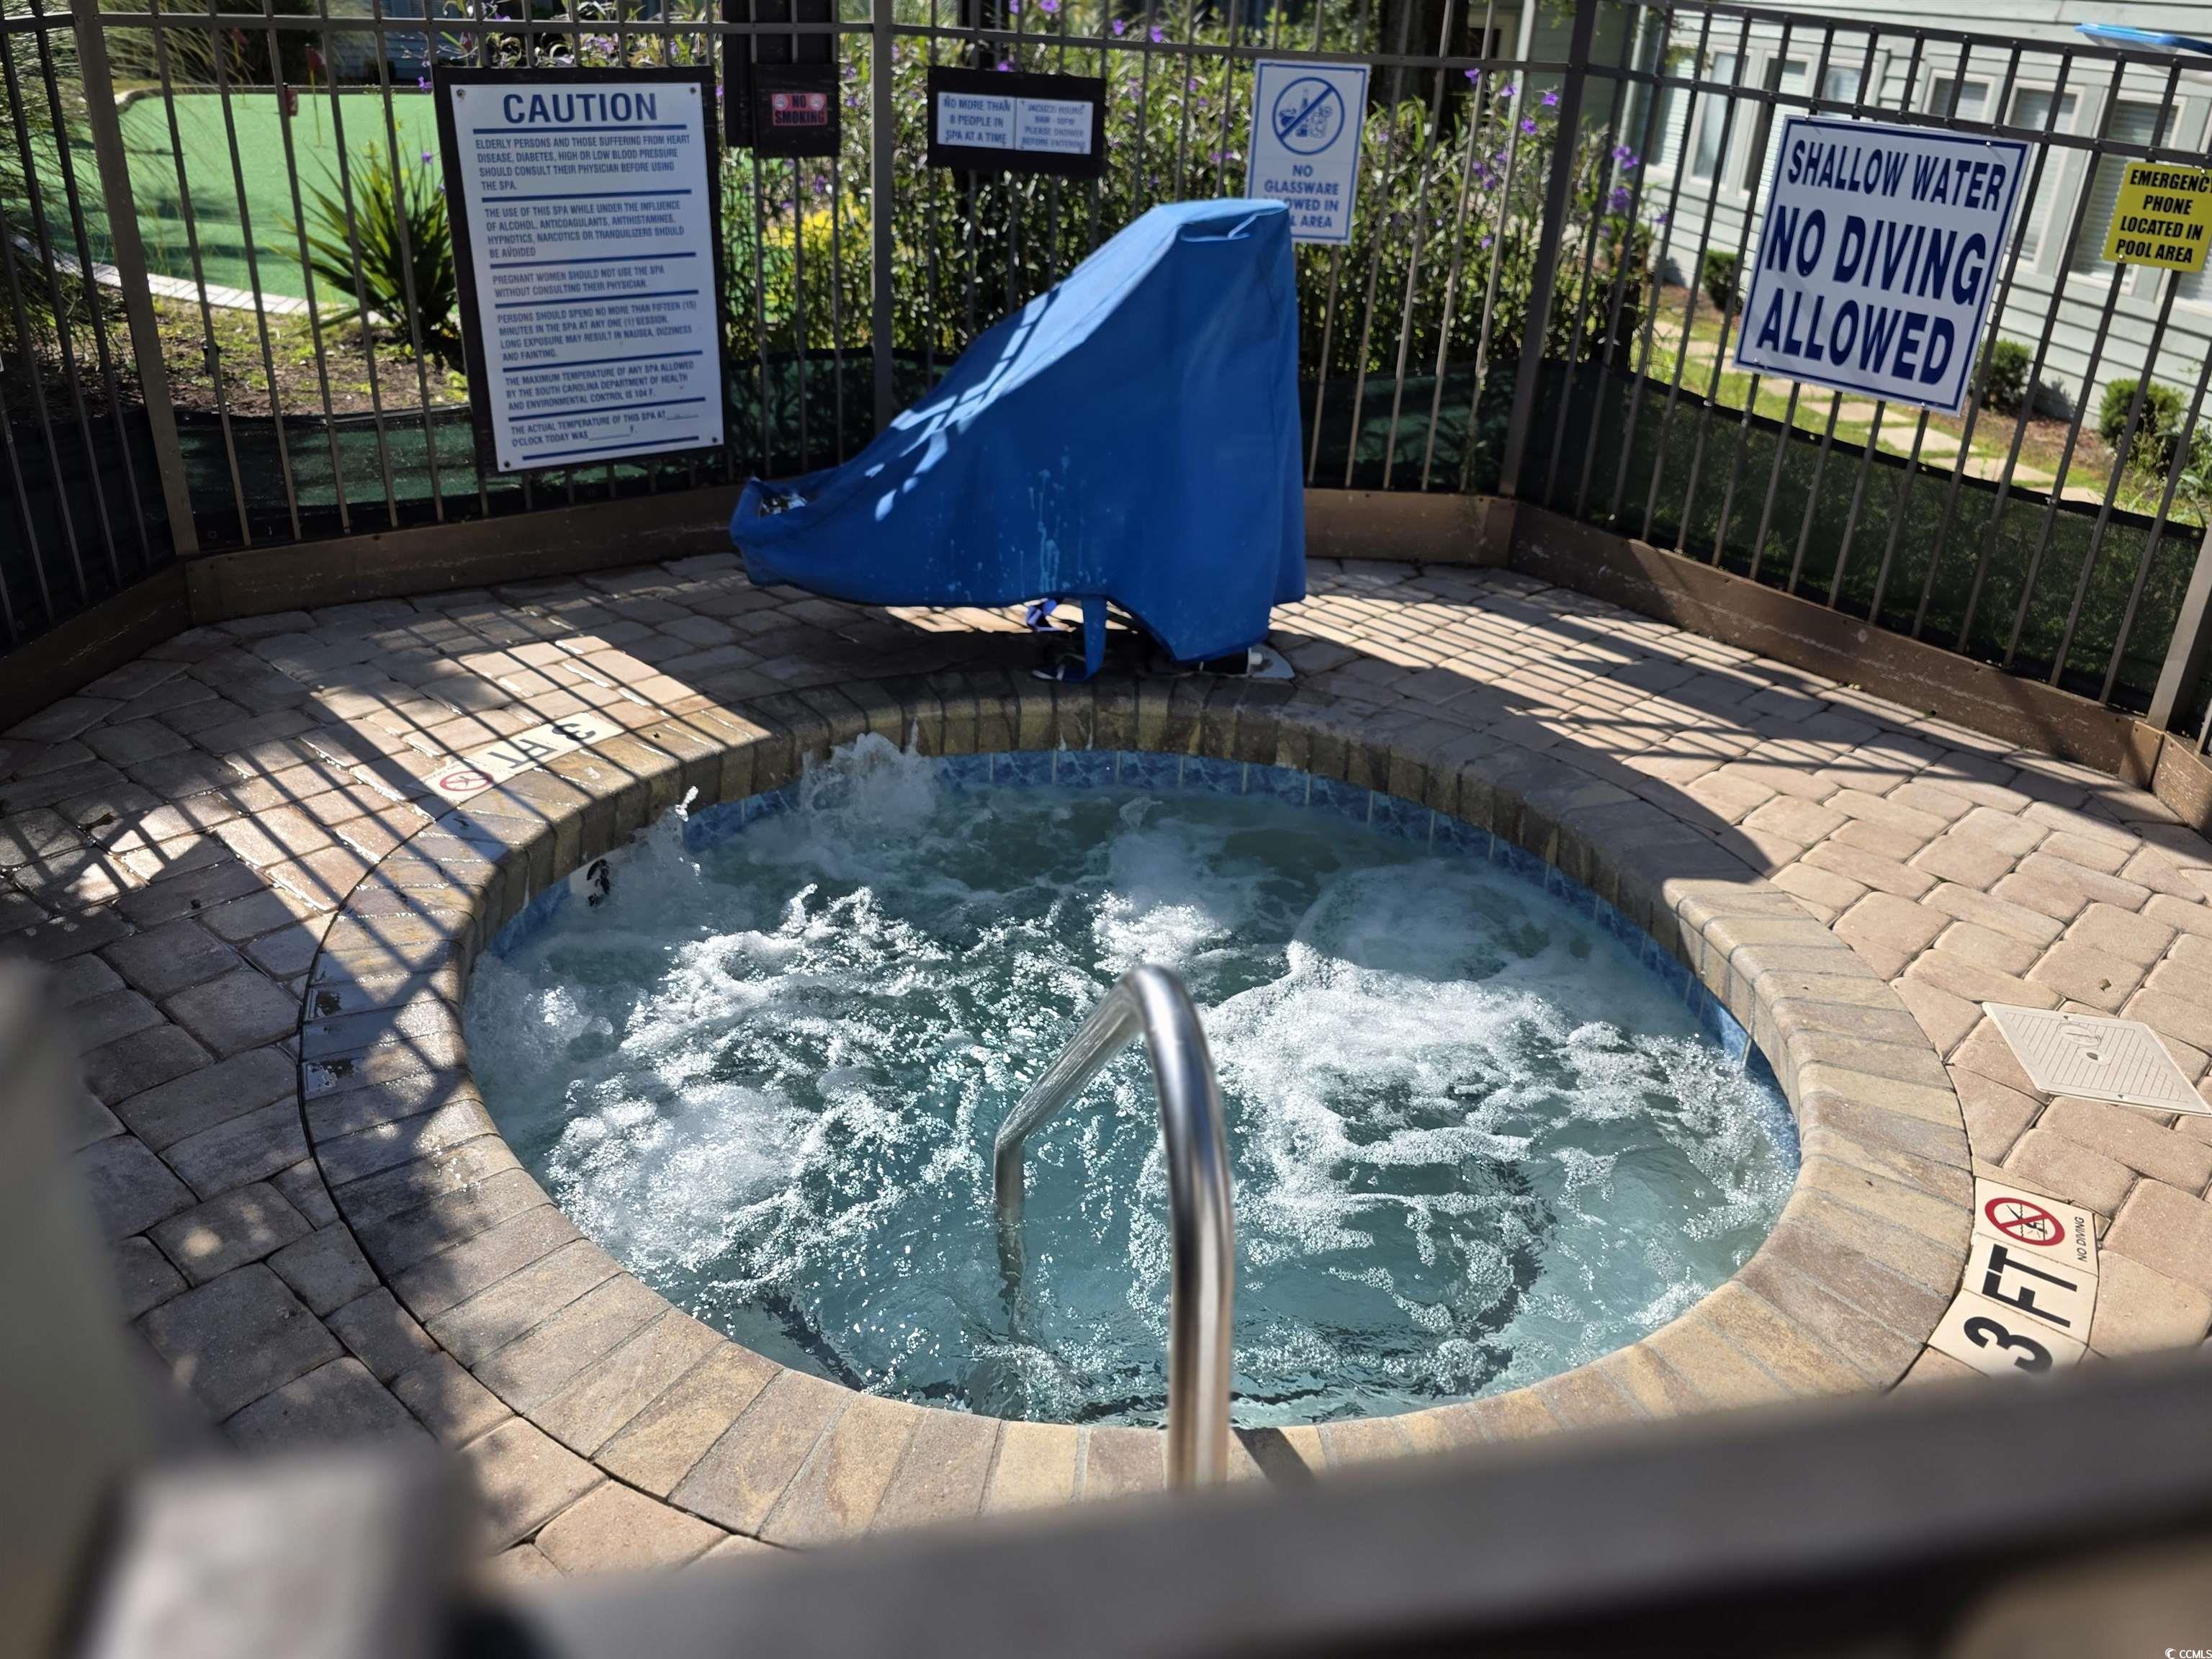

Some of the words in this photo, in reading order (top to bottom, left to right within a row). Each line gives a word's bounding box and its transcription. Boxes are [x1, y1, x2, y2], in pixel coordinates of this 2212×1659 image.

[503, 93, 657, 124] CAUTION
[793, 95, 806, 108] NO
[944, 99, 956, 108] NO
[958, 99, 984, 110] MORE
[986, 102, 1010, 111] THAN
[775, 111, 824, 123] SMOKING
[958, 115, 992, 127] PEOPLE
[994, 117, 1004, 127] IN
[475, 138, 511, 149] ELDERLY
[513, 138, 551, 148] PERSONS
[553, 138, 570, 147] AND
[571, 137, 597, 147] THOSE
[598, 135, 641, 146] SUFFERING
[642, 135, 665, 145] FROM
[666, 134, 690, 144] HEART
[945, 130, 962, 140] SPA
[965, 131, 975, 140] AT
[978, 132, 984, 142] A
[985, 132, 1006, 143] TIME
[558, 150, 577, 161] HIGH
[580, 150, 591, 160] OR
[592, 150, 610, 160] LOW
[612, 149, 637, 159] BLOOD
[639, 148, 678, 158] PRESSURE
[479, 166, 512, 177] SHOULD
[514, 165, 550, 176] CONSULT
[553, 164, 576, 174] THEIR
[577, 163, 619, 174] PHYSICIAN
[621, 162, 649, 172] BEFORE
[651, 161, 674, 171] USING
[1292, 165, 1313, 177] NO
[1787, 140, 1908, 197] SHALLOW
[1911, 154, 2006, 211] WATER
[481, 181, 496, 191] THE
[1264, 180, 1339, 195] GLASSWARE
[485, 207, 500, 217] THE
[502, 207, 518, 217] USE
[520, 207, 531, 216] OF
[532, 205, 551, 215] THIS
[552, 204, 568, 215] SPA
[570, 204, 594, 214] WHILE
[596, 202, 622, 212] UNDER
[624, 202, 639, 211] THE
[640, 199, 680, 210] INFLUENCE
[1324, 200, 1339, 212] IN
[2143, 194, 2193, 215] PHONE
[486, 222, 497, 232] OF
[1300, 215, 1332, 228] AREA
[2120, 216, 2183, 238] LOCATED
[2186, 224, 2203, 240] IN
[536, 231, 580, 243] NARCOTICS
[583, 230, 593, 240] OR
[654, 226, 684, 236] SHOULD
[489, 248, 500, 258] BE
[501, 246, 536, 258] AVOIDED
[1765, 205, 1826, 278] NO
[1833, 215, 1987, 305] DIVING
[2116, 239, 2152, 258] POOL
[2154, 244, 2193, 263] AREA
[493, 273, 534, 285] PREGNANT
[536, 271, 567, 282] WOMEN
[568, 269, 599, 280] SHOULD
[601, 268, 616, 278] NOT
[617, 266, 632, 276] USE
[634, 266, 647, 276] THE
[649, 265, 664, 274] SPA
[495, 287, 530, 298] WITHOUT
[532, 283, 581, 295] CONSULTING
[583, 282, 605, 292] THEIR
[497, 313, 534, 324] PERSONS
[536, 310, 567, 321] SHOULD
[569, 308, 593, 318] SPEND
[595, 307, 606, 317] NO
[608, 305, 630, 315] MORE
[631, 304, 650, 314] THAN
[499, 325, 534, 336] MINUTES
[535, 324, 544, 333] IN
[546, 323, 560, 333] THE
[562, 322, 577, 331] SPA
[578, 320, 588, 330] AT
[590, 319, 605, 329] ANY
[607, 318, 622, 328] ONE
[500, 339, 522, 349] LONG
[523, 336, 563, 348] EXPOSURE
[565, 334, 582, 344] MAY
[584, 332, 612, 343] RESULT
[613, 331, 622, 340] IN
[1755, 288, 1955, 385] ALLOWED
[502, 352, 518, 361] AND
[505, 377, 520, 386] THE
[522, 373, 560, 385] MAXIMUM
[562, 368, 615, 381] TEMPERATURE
[616, 367, 626, 375] OF
[628, 365, 642, 374] ANY
[644, 364, 658, 373] SPA
[660, 361, 694, 372] ALLOWED
[506, 390, 517, 399] BY
[518, 388, 533, 397] THE
[534, 385, 560, 396] SOUTH
[562, 382, 599, 393] CAROLINA
[601, 377, 648, 390] DEPARTMENT
[649, 376, 659, 385] OF
[661, 373, 688, 384] HEALTH
[508, 401, 525, 411] AND
[526, 395, 588, 409] ENVIRONMENTAL
[590, 391, 624, 403] CONTROL
[625, 390, 632, 399] IS
[511, 425, 525, 435] THE
[527, 422, 556, 433] ACTUAL
[558, 416, 610, 430] TEMPERATURE
[612, 415, 621, 424] OF
[623, 413, 639, 423] THIS
[642, 411, 655, 421] SPA
[657, 410, 665, 419] AT
[544, 432, 570, 443] TODAY
[571, 430, 588, 440] WAS
[2074, 1216, 2086, 1245] DIVING
[2077, 1246, 2087, 1262] NO
[1982, 1244, 2077, 1328] FT
[1964, 1316, 2053, 1373] 3
